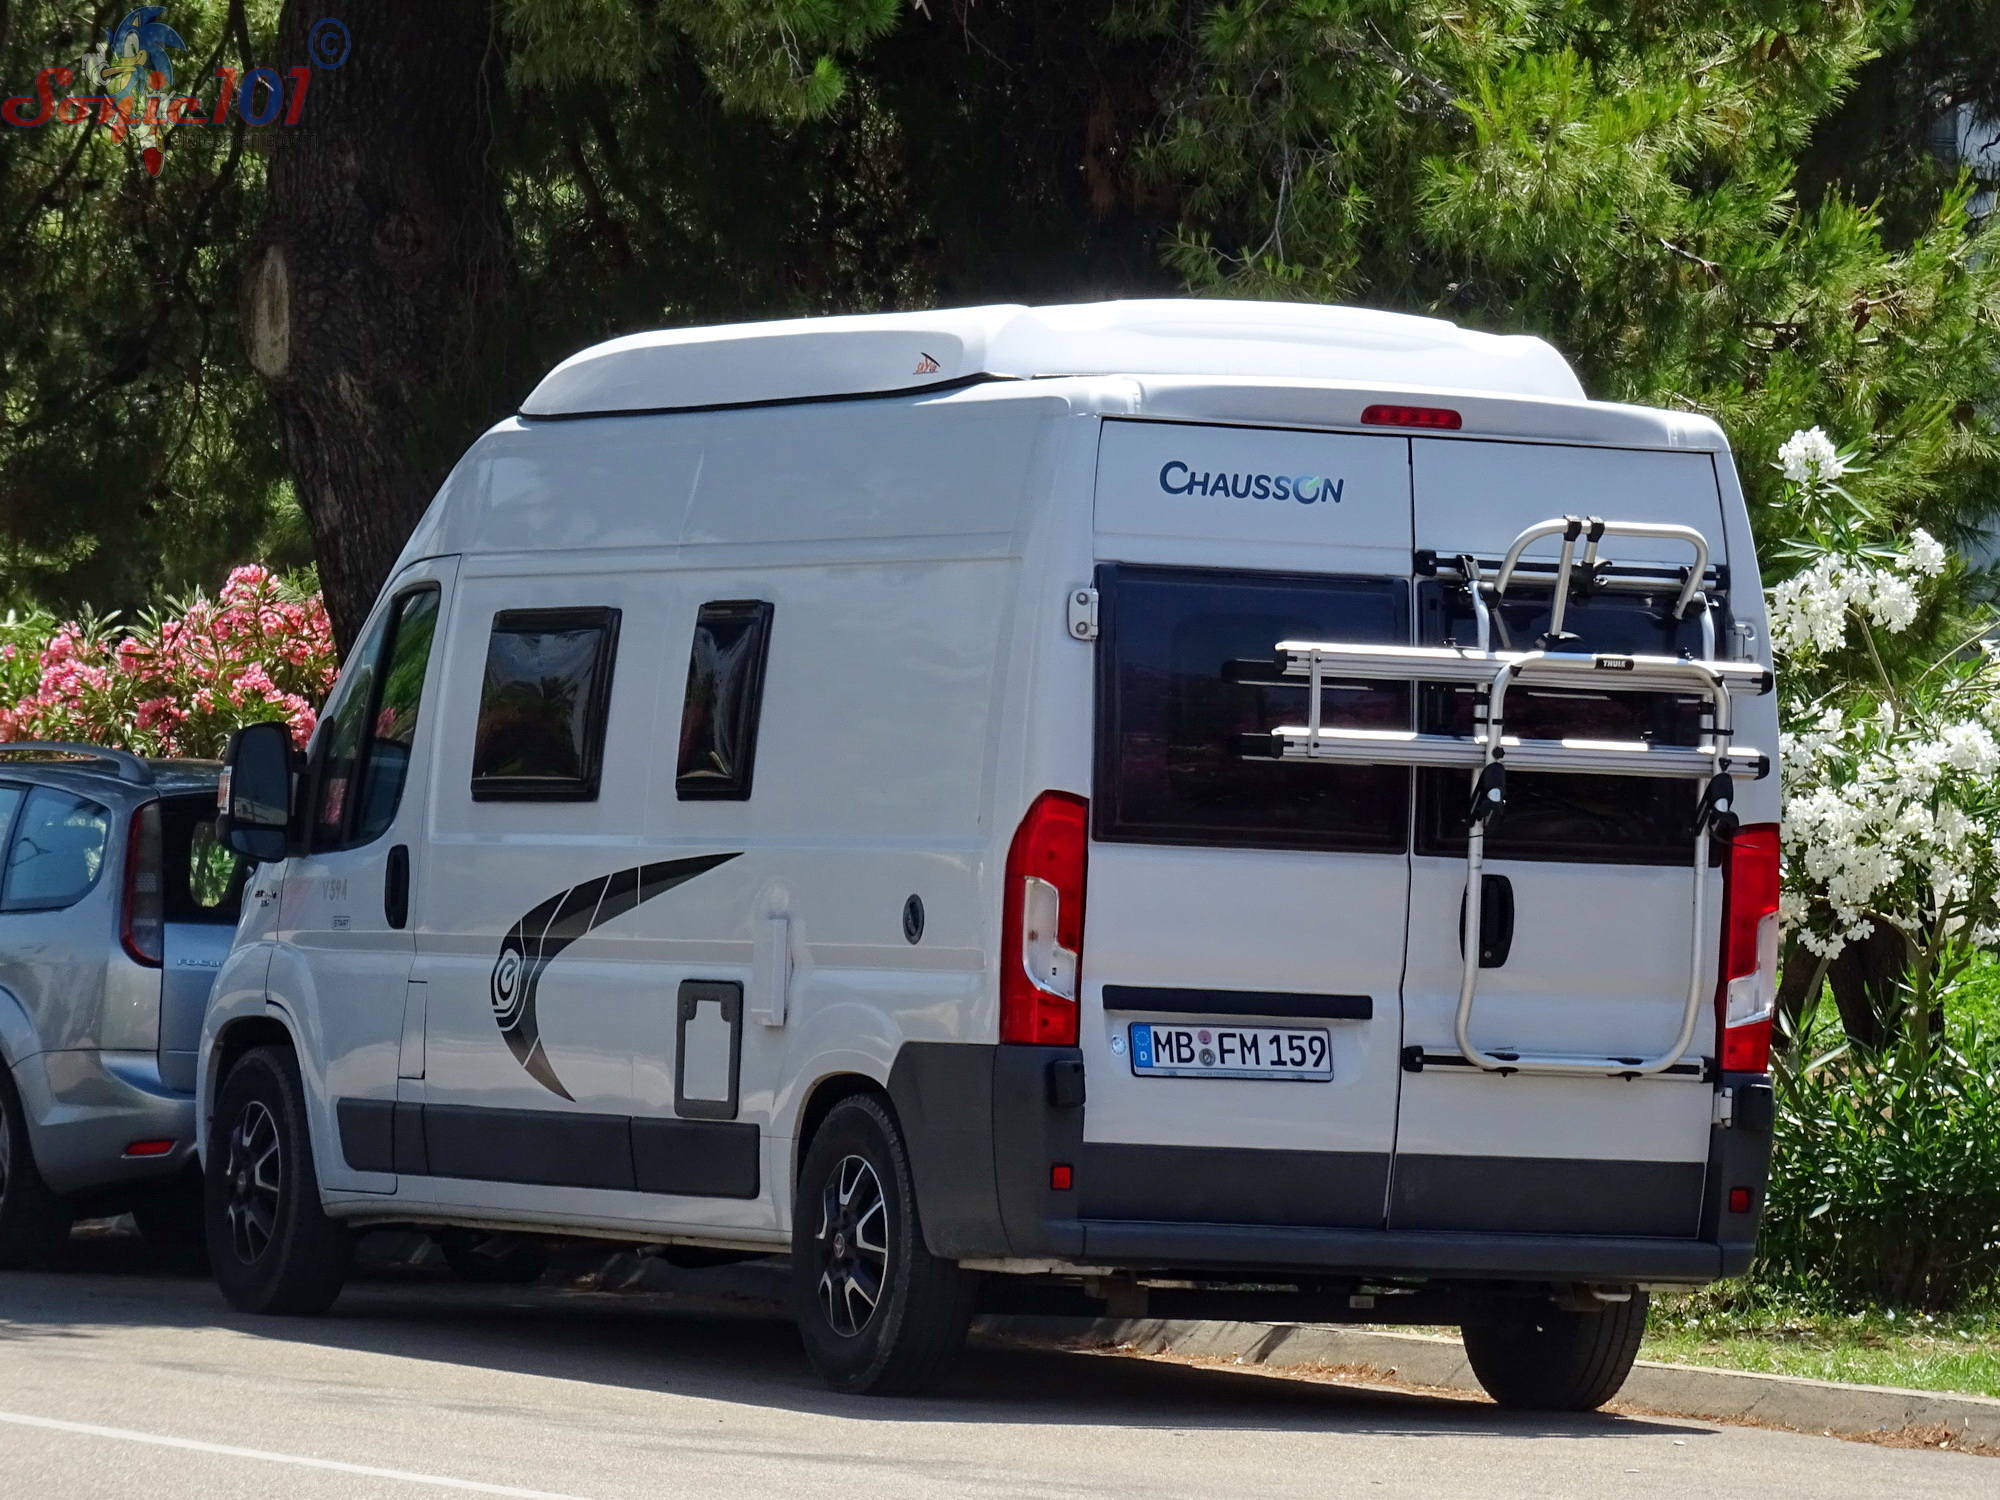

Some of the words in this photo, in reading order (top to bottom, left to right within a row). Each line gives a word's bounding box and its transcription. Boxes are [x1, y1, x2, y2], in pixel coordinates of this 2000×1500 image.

[1603, 660, 1626, 668] THULE
[1153, 1031, 1195, 1064] MB
[1218, 1033, 1261, 1065] FM
[1269, 1035, 1326, 1067] 159
